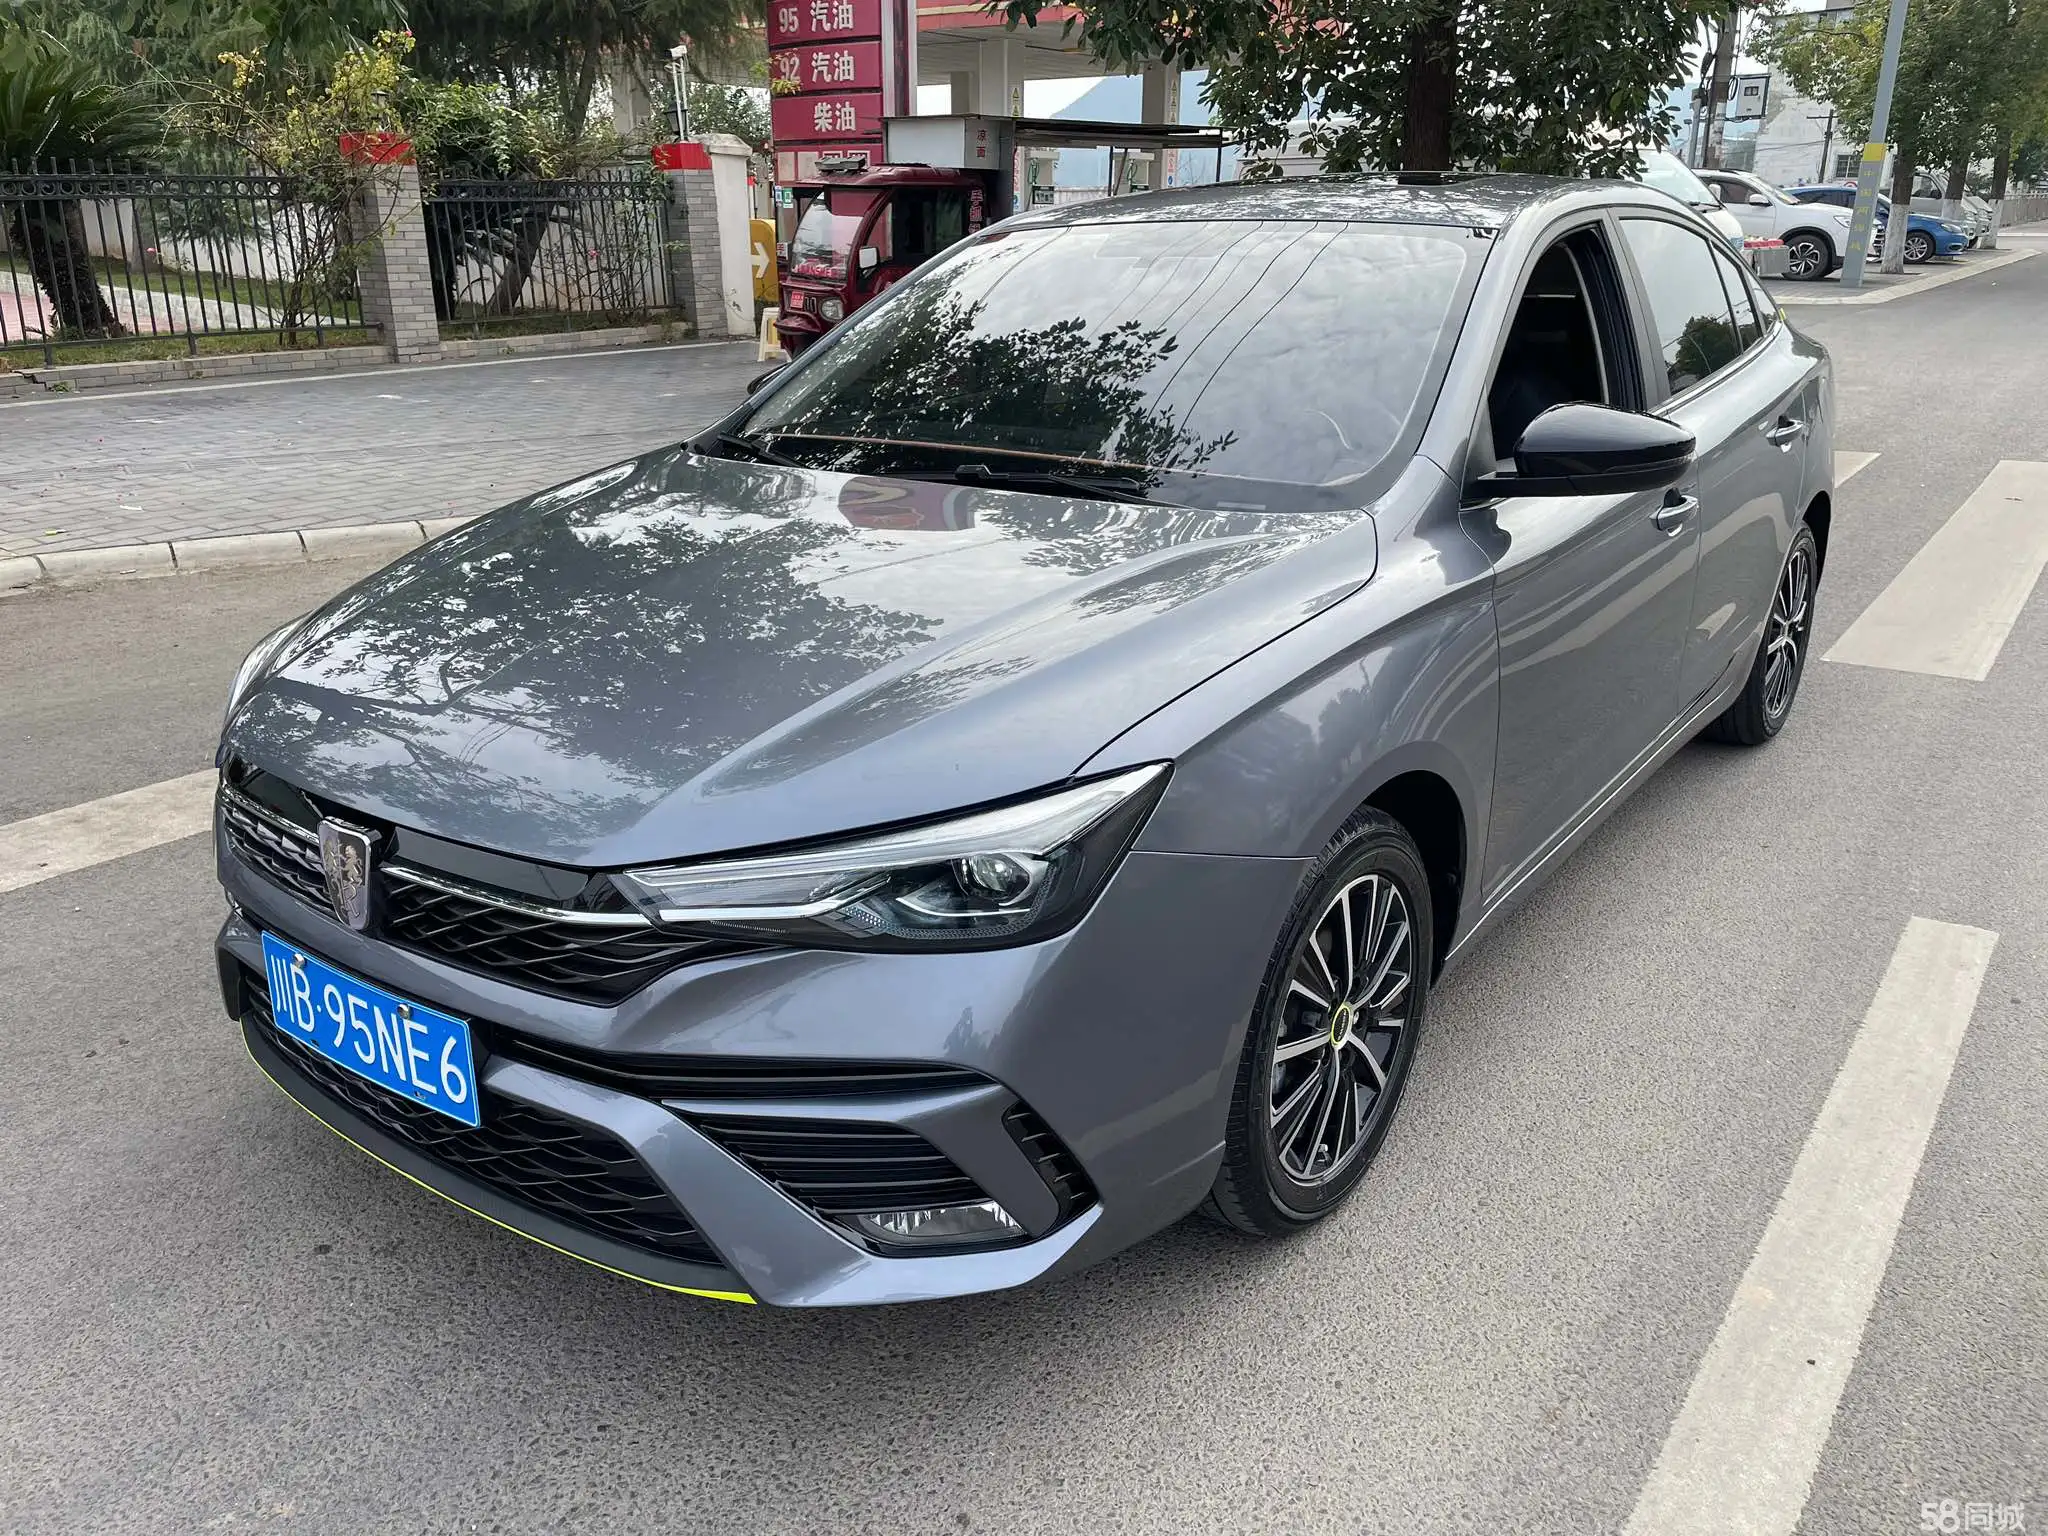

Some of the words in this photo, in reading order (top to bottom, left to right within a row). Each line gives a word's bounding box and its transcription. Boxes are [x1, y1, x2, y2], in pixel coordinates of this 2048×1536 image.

[778, 7, 800, 33] 95
[810, 0, 854, 32] 汽油
[779, 54, 800, 83] 92
[811, 50, 855, 83] 汽油
[814, 101, 857, 132] 柴油
